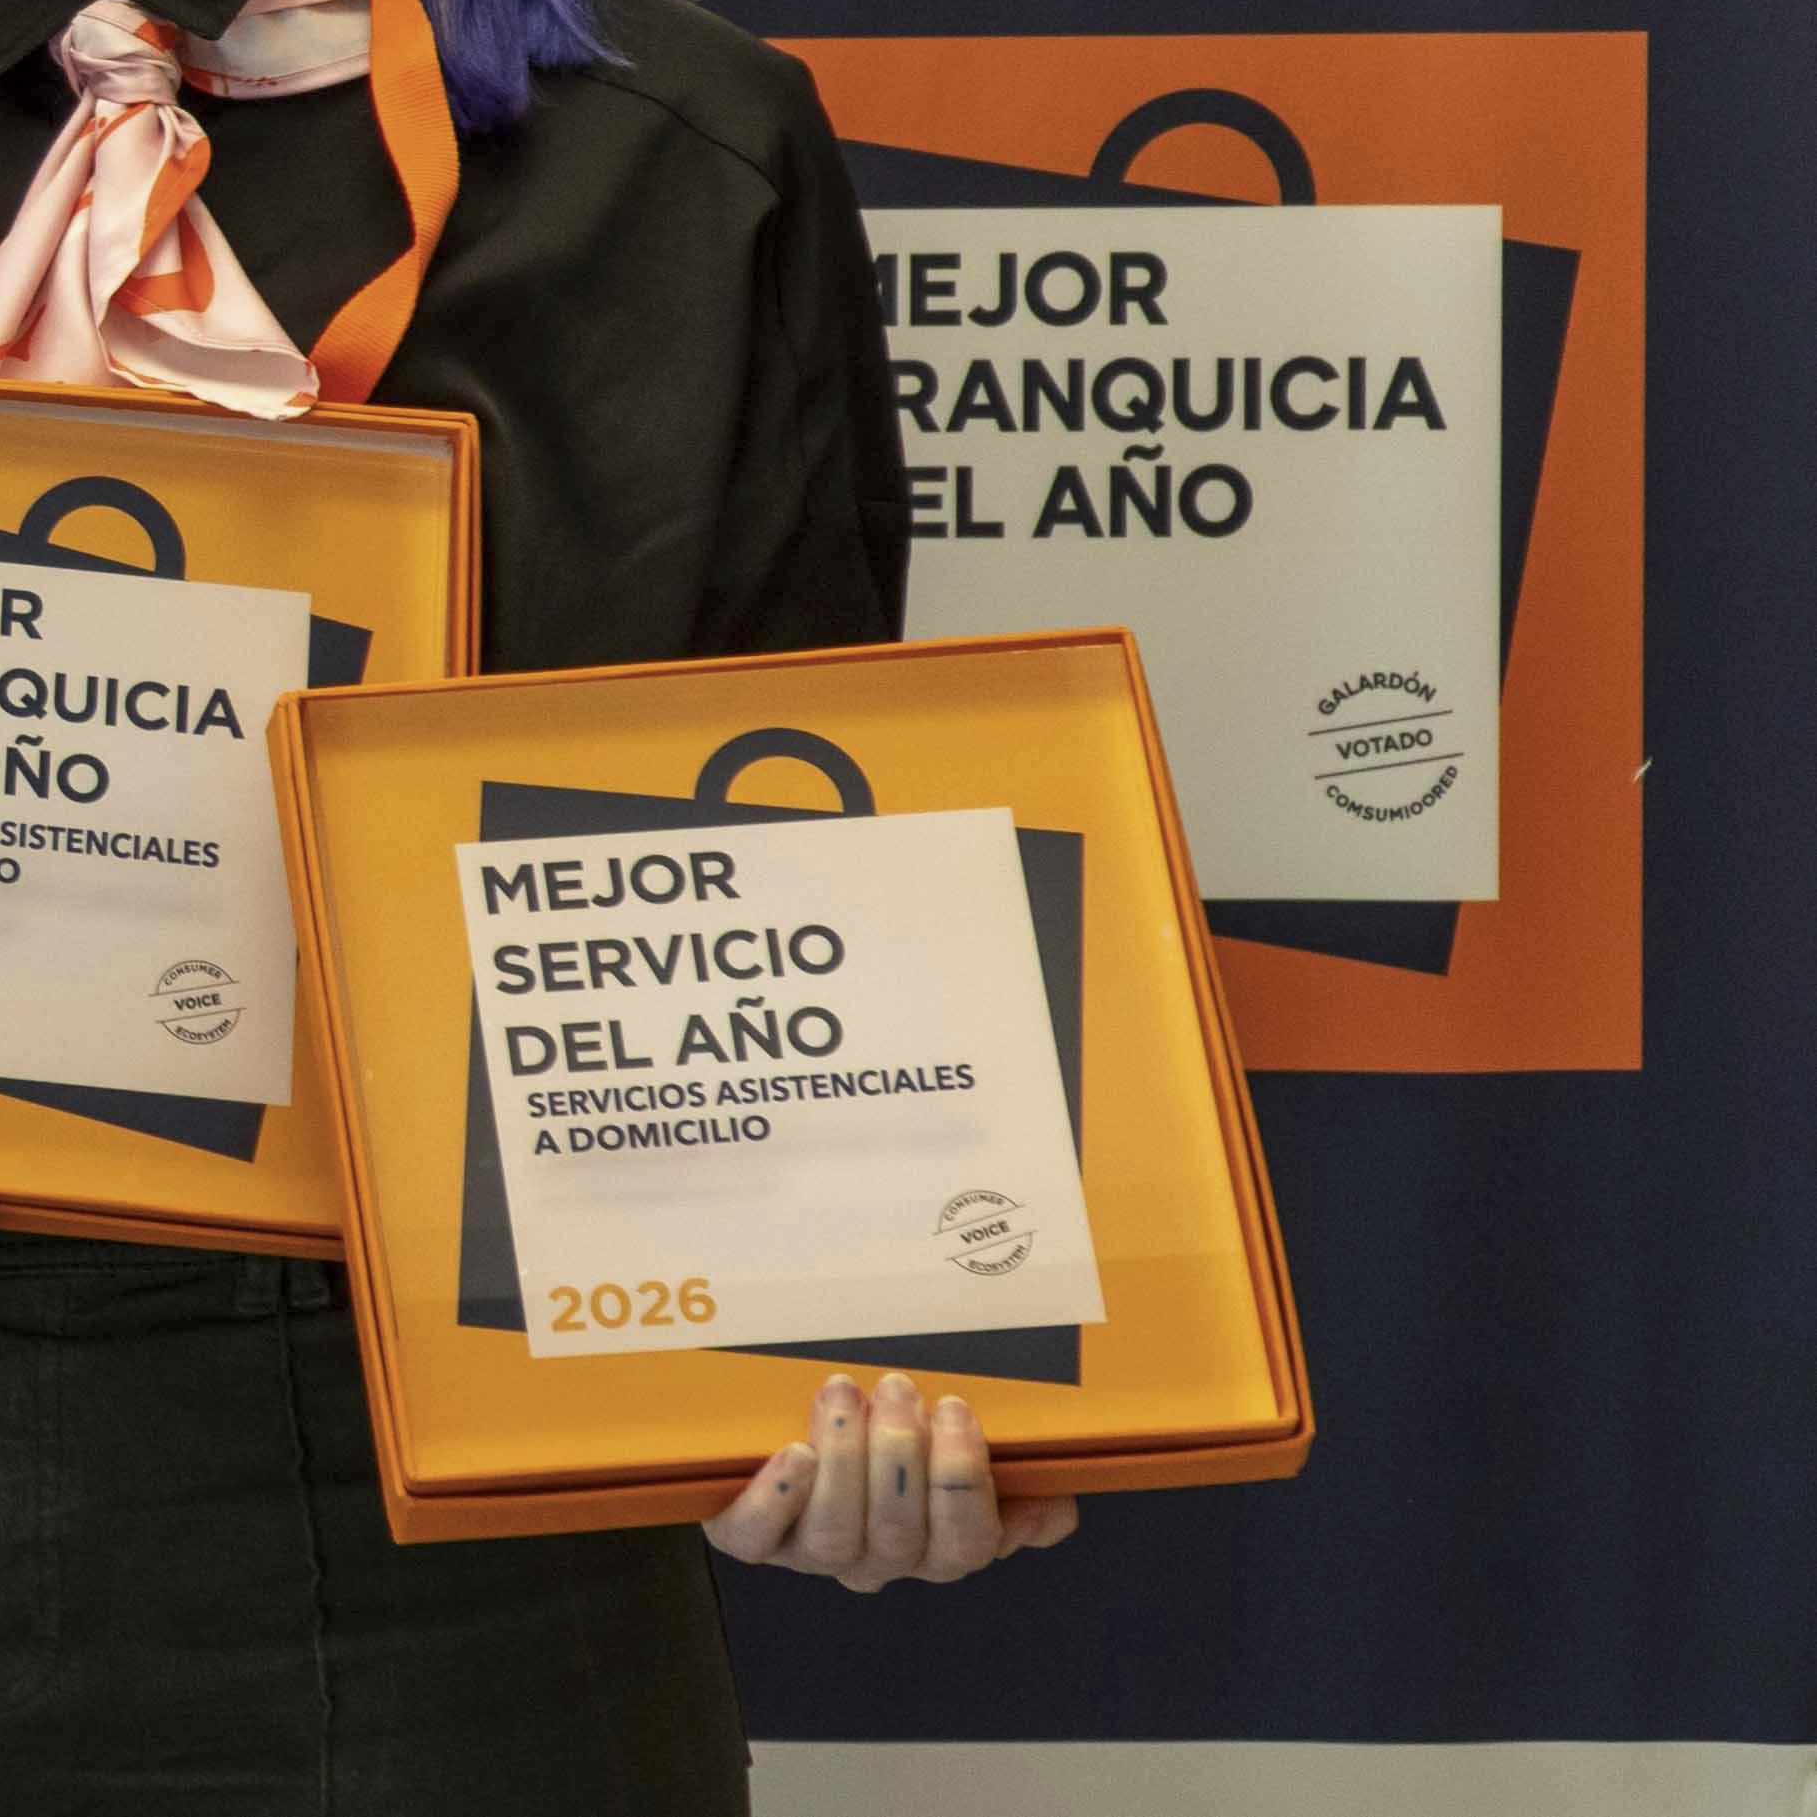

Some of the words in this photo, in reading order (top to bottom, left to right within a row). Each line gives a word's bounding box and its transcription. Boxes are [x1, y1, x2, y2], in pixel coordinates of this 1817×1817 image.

[890, 356, 1445, 434] RANQUICIA
[908, 466, 1005, 539] EL
[1033, 444, 1252, 538] AÑO
[1318, 671, 1437, 716] GALARDÓN
[1336, 729, 1433, 760] VOTADO
[481, 852, 740, 914] MEJOR
[494, 925, 844, 994] SERVICIO
[173, 993, 222, 1011] VOICE
[505, 1020, 653, 1076] DEL
[677, 996, 842, 1066] AÑO
[528, 1082, 706, 1118] SERVICIOS
[717, 1064, 975, 1105] ASISTENCIALES
[535, 1130, 561, 1155] A
[568, 1116, 770, 1152] DOMICILIO
[960, 1220, 1011, 1244] VOICE
[549, 1278, 716, 1332] 2026
